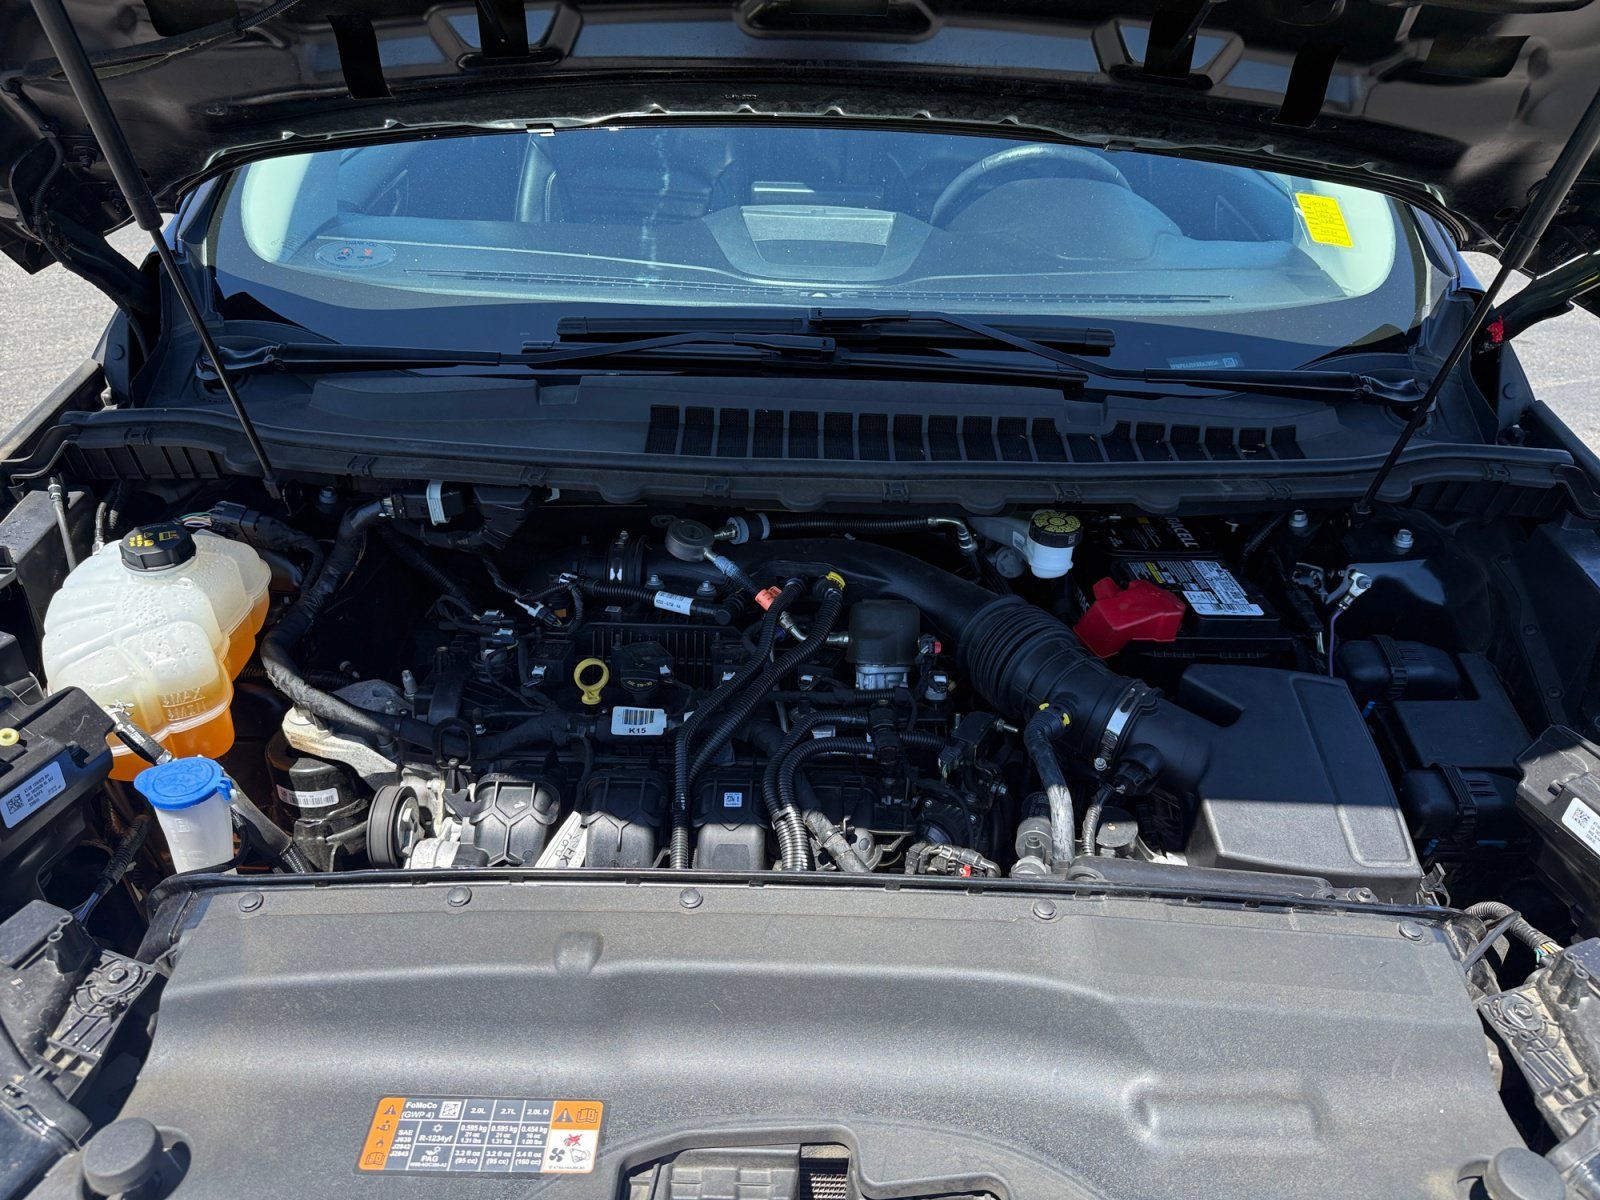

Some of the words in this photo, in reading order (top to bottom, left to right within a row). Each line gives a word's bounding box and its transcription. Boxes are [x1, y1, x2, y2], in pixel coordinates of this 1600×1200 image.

[1164, 516, 1200, 548] RACELL
[401, 1110, 424, 1119] (GWP
[425, 1111, 435, 1120] 4)
[419, 1135, 453, 1143] R-1234yf
